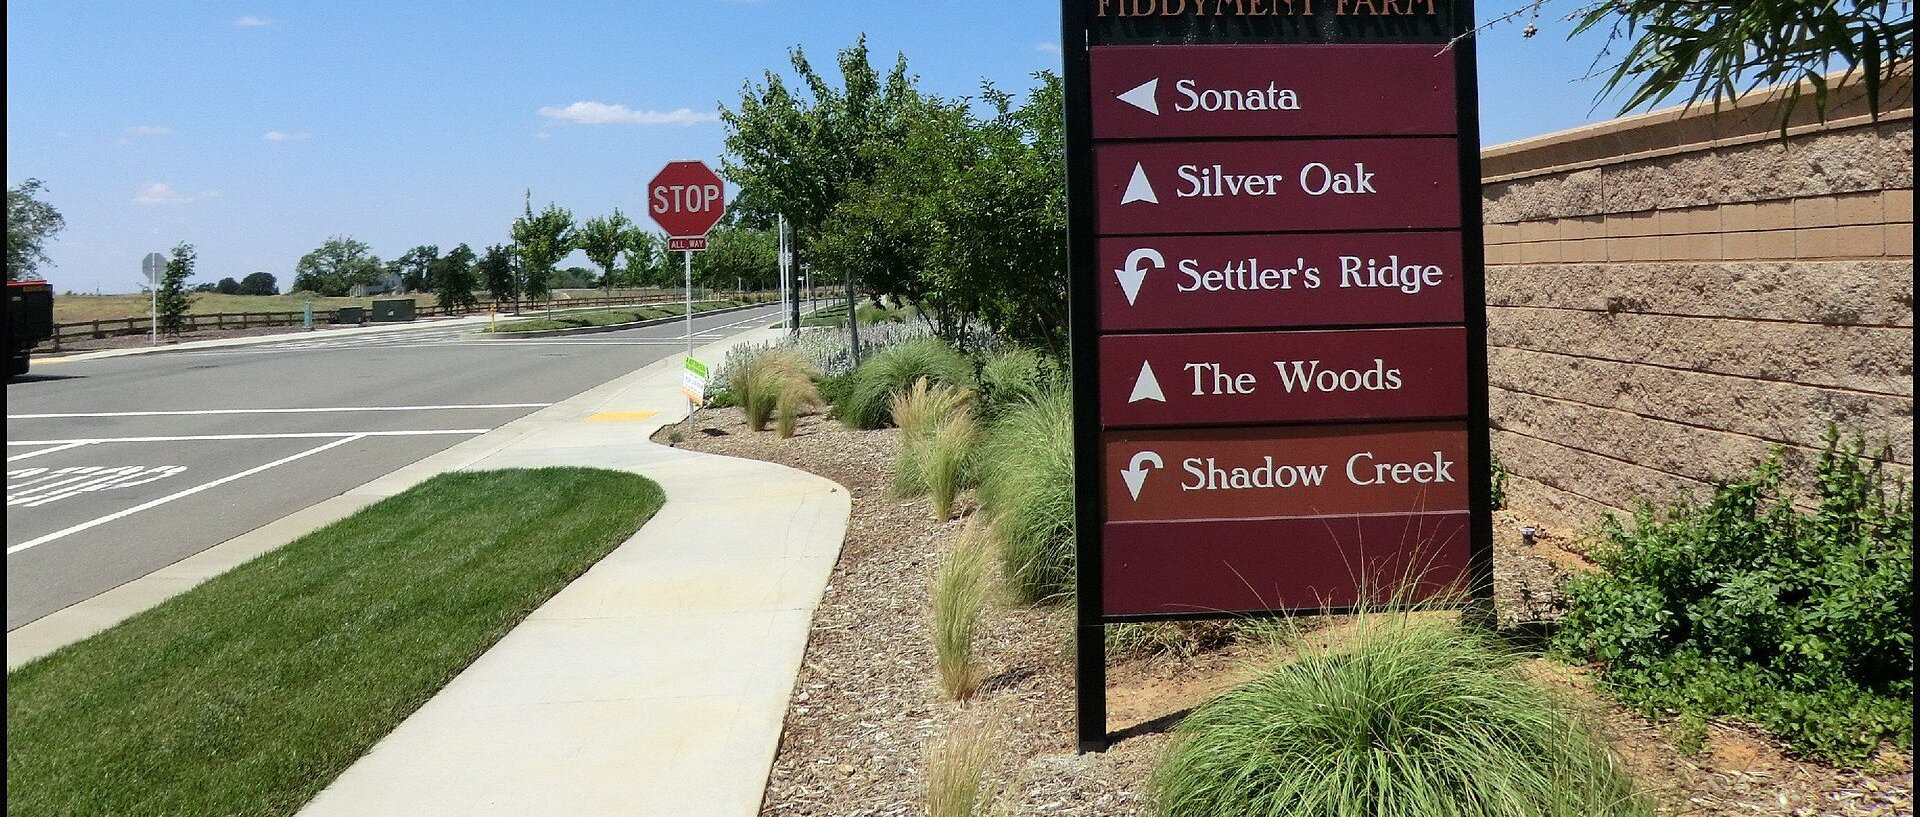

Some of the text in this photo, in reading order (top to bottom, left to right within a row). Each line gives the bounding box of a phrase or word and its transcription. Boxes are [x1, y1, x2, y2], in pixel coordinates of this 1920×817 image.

[1336, 0, 1437, 16] FARM
[1174, 80, 1301, 112] Sonata
[1176, 162, 1377, 198] Silver Oak
[653, 184, 720, 213] STOP
[671, 239, 704, 249] ALL WAY
[1176, 254, 1444, 294] Settler's Ridge
[1183, 358, 1402, 396] The Woods
[1180, 450, 1456, 492] Shadow Creek
